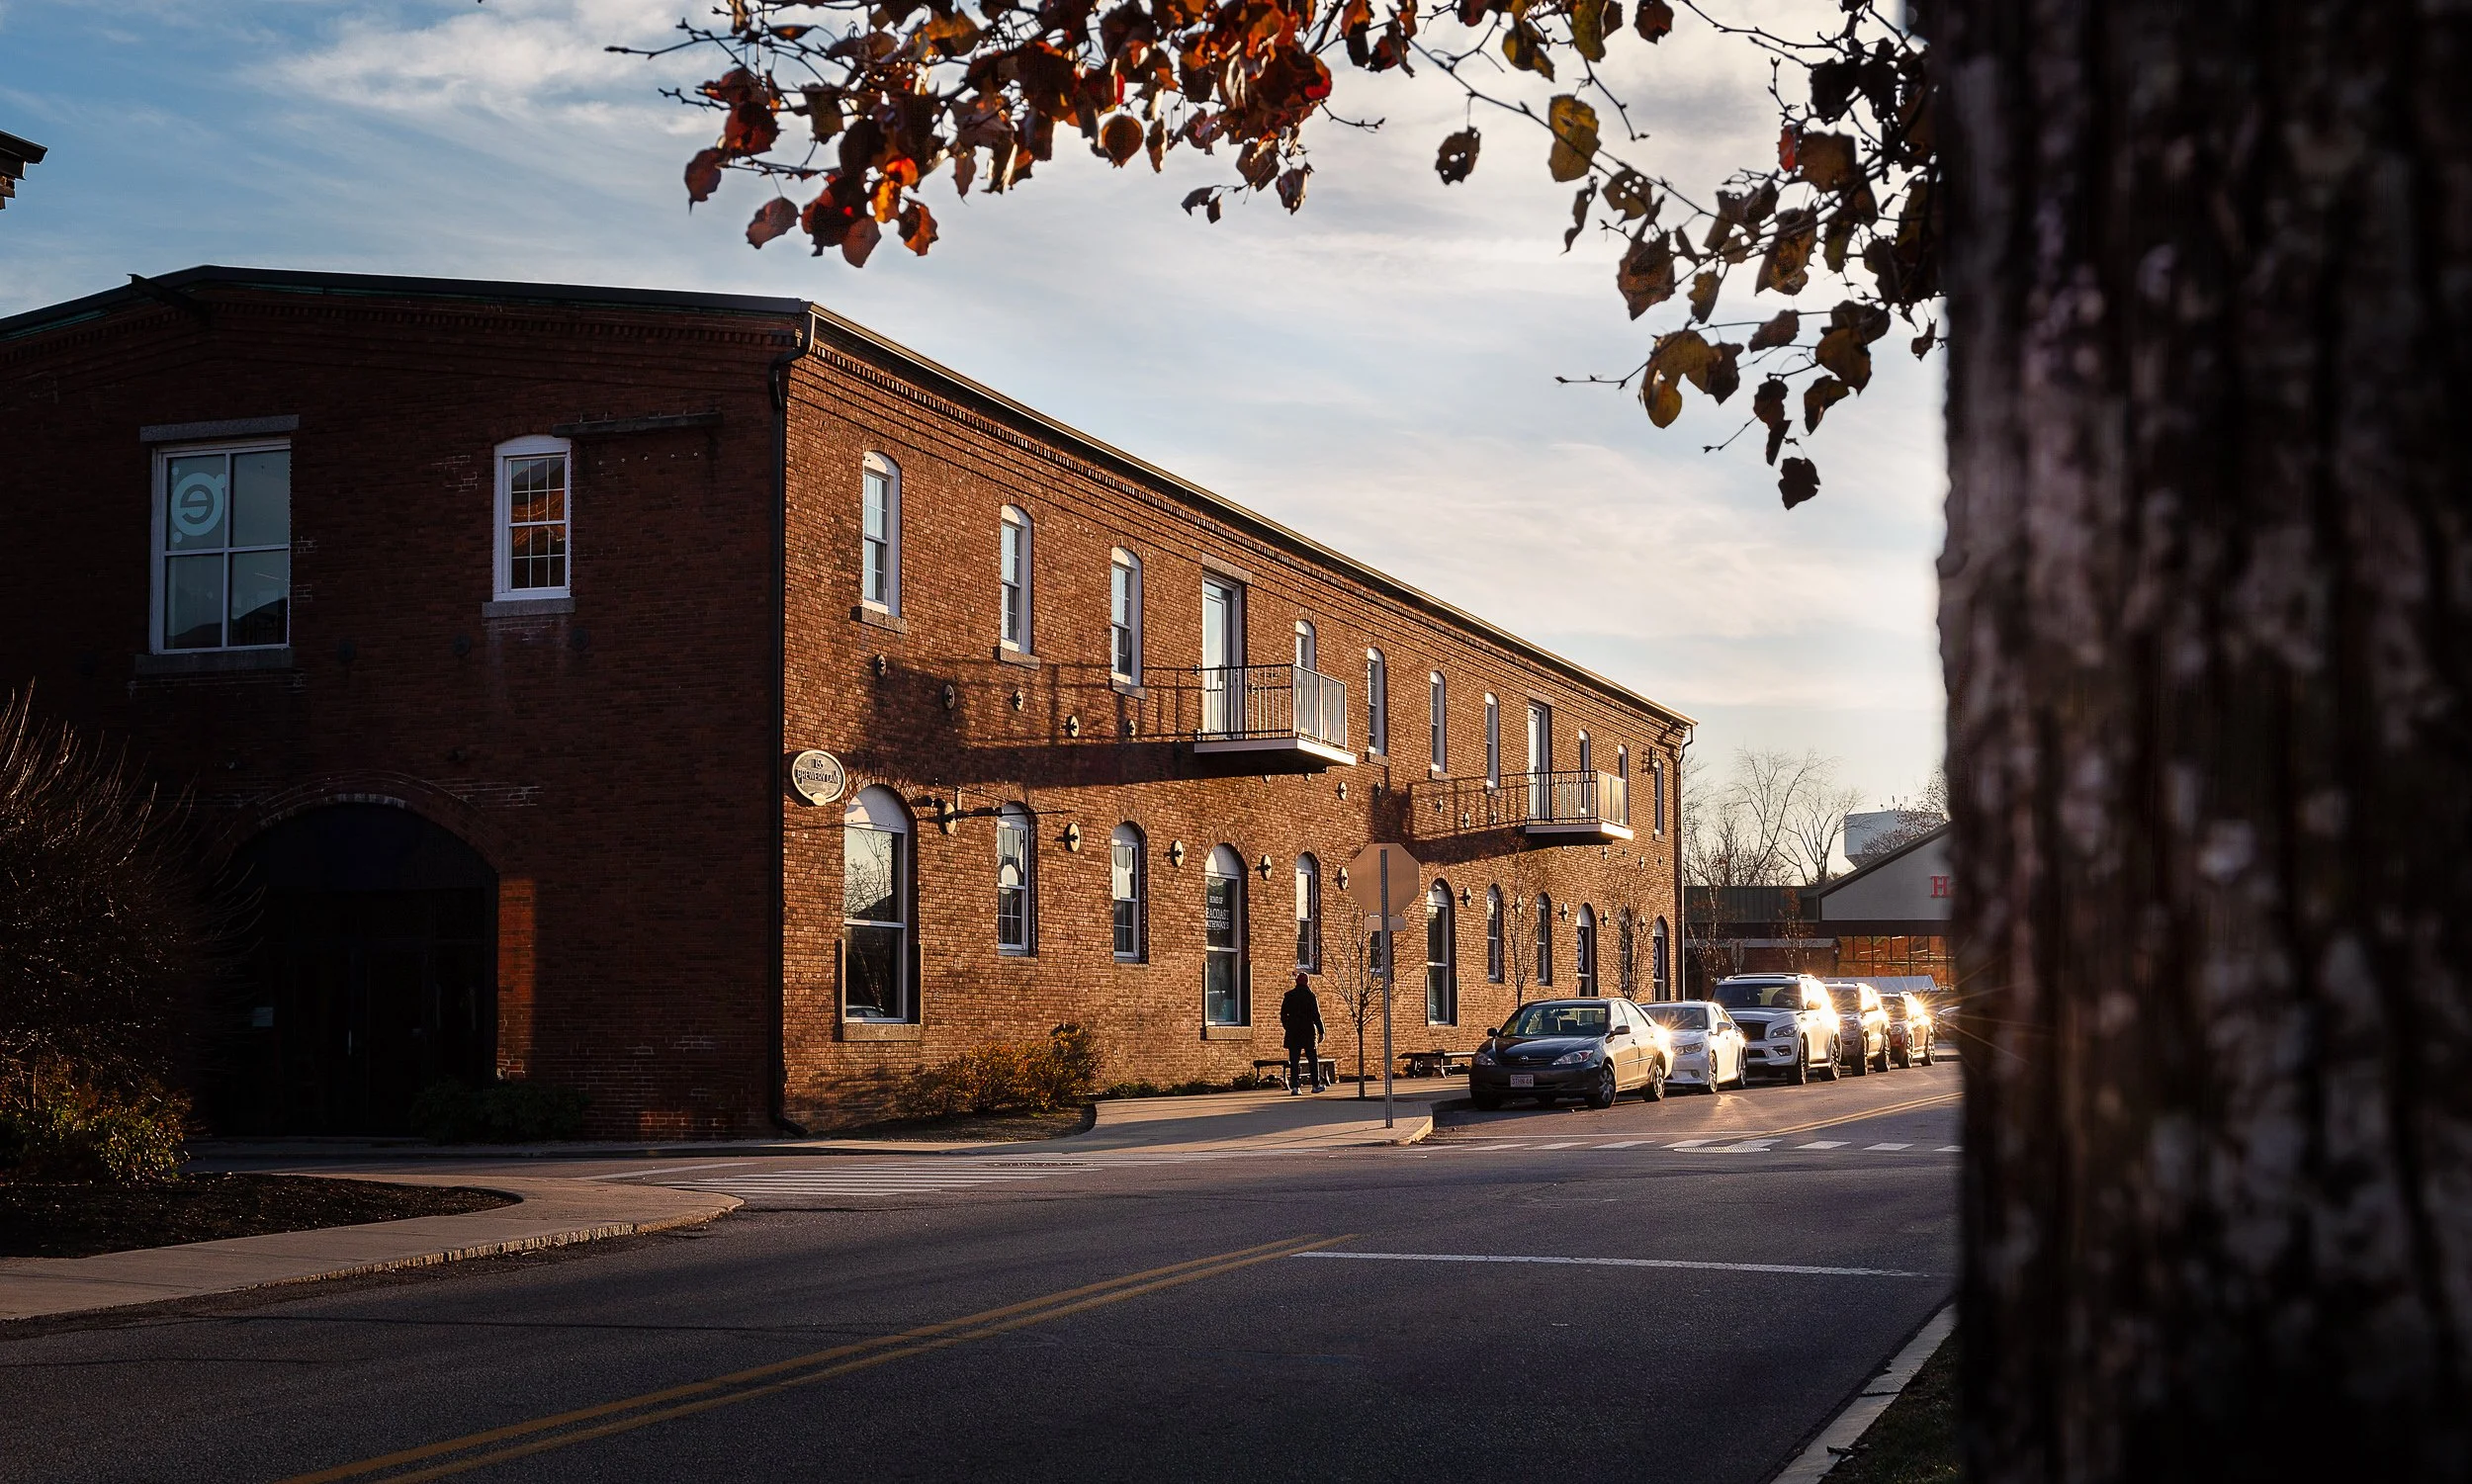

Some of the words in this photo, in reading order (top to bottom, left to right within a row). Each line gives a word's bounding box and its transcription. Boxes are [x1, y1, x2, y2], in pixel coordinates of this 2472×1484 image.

[796, 769, 826, 783] BREWERY
[1205, 907, 1229, 919] EACOAST
[1205, 919, 1229, 929] ATHWAYS
